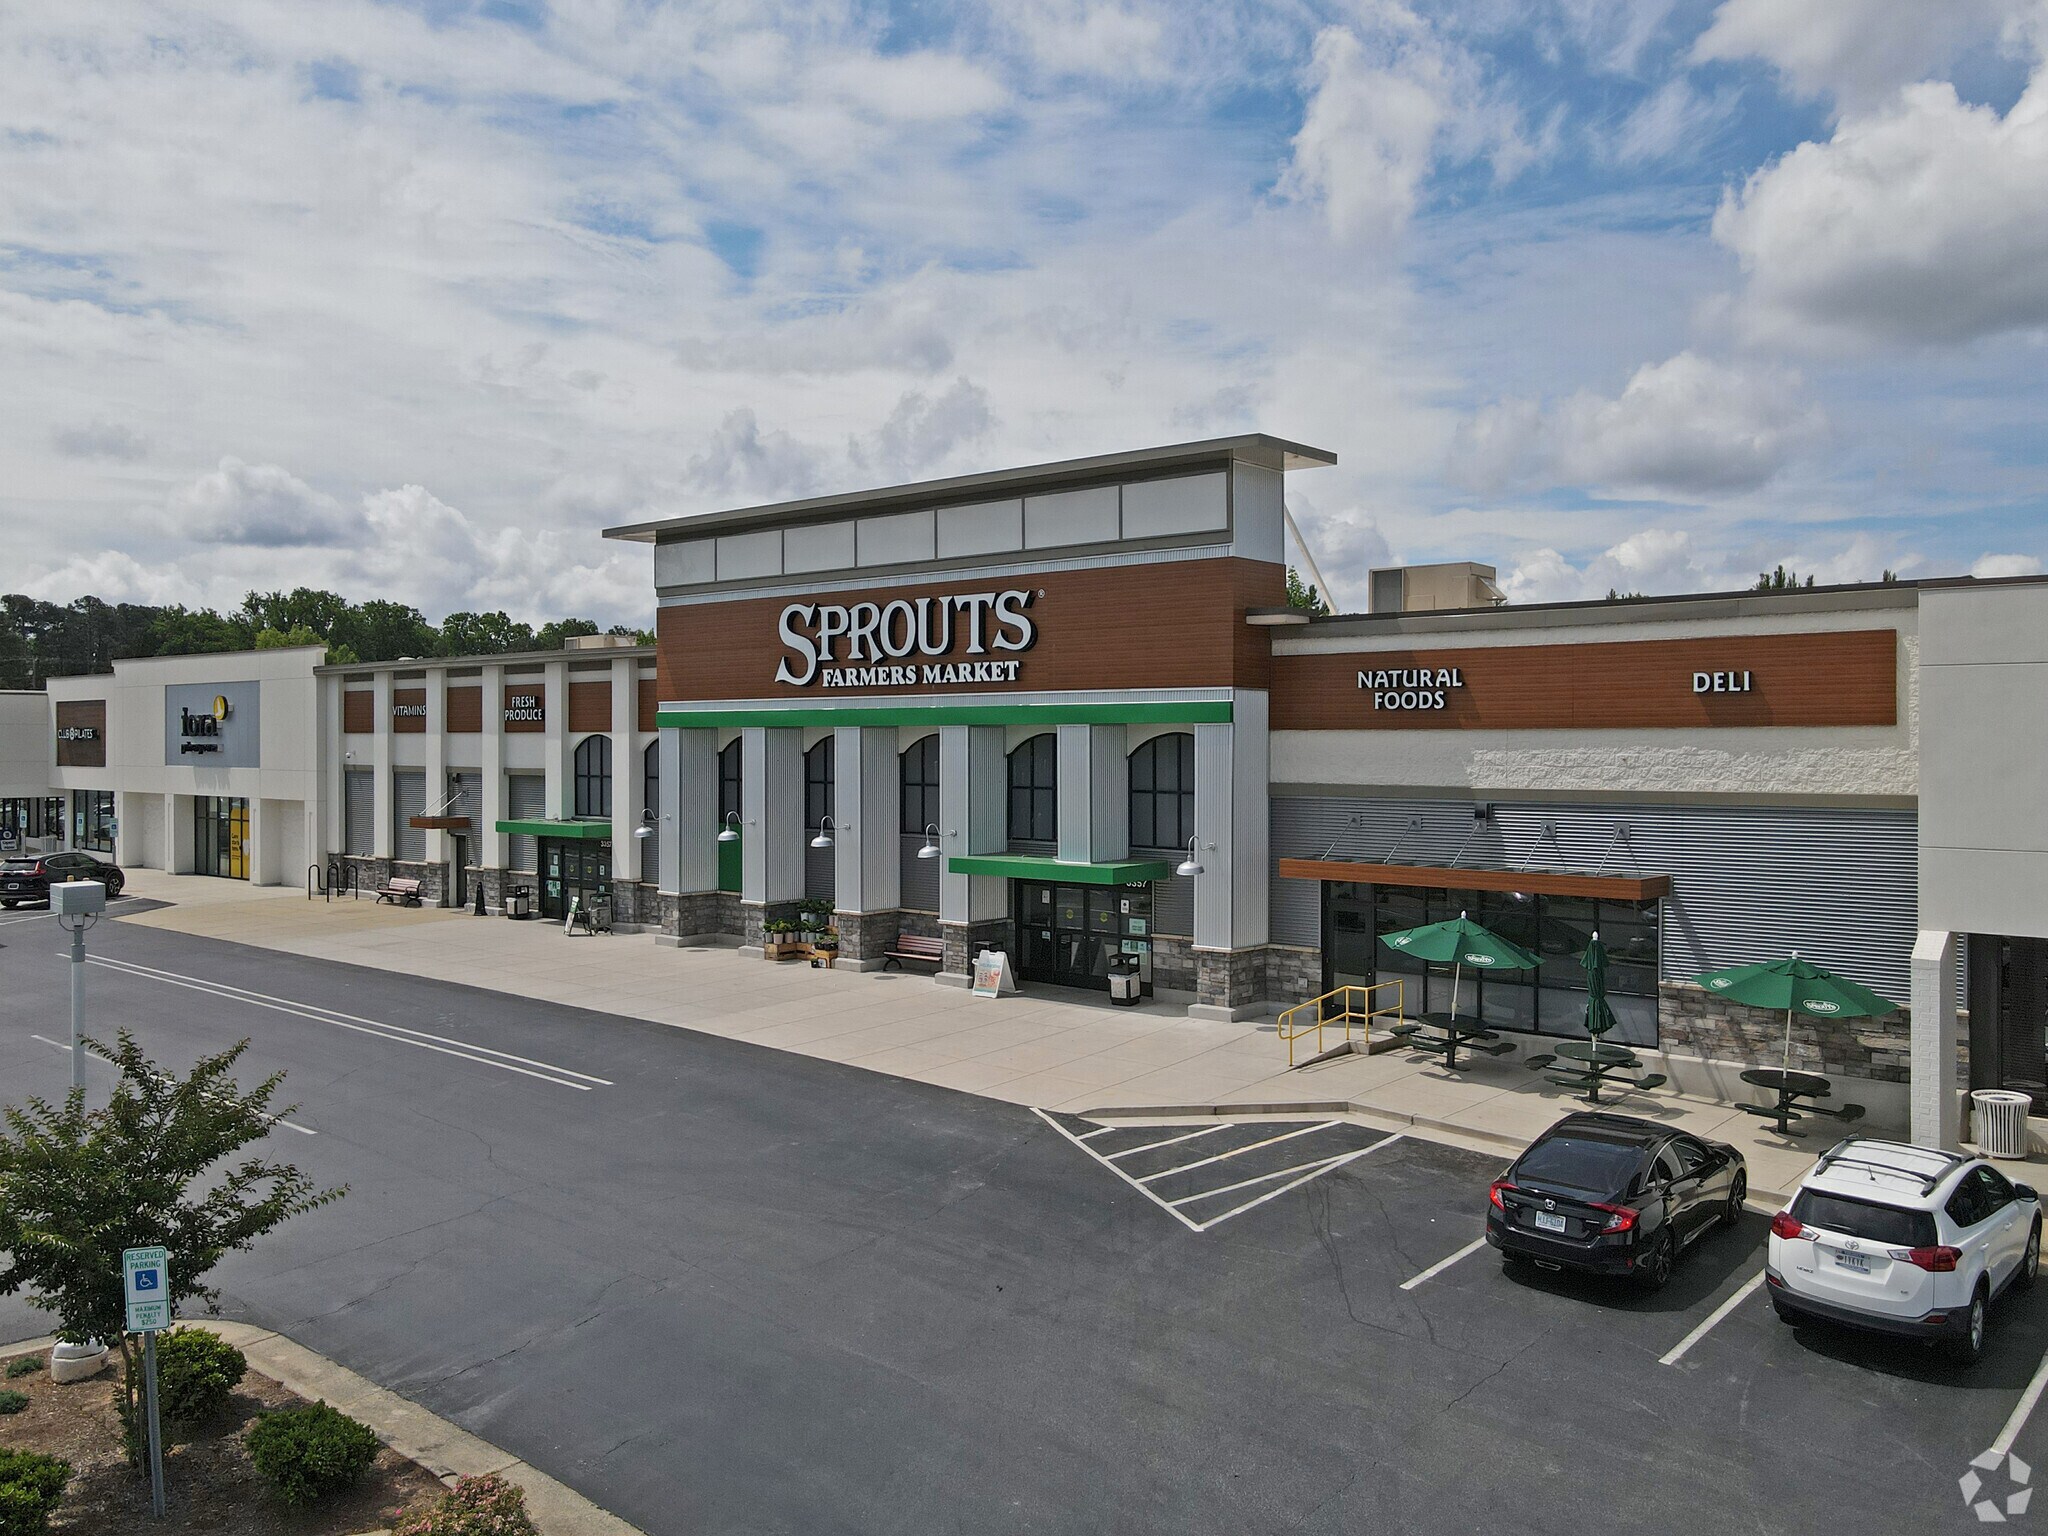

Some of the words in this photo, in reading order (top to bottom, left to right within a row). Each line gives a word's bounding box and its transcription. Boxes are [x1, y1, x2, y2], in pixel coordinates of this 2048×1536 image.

[775, 590, 1033, 686] SPROUTS
[822, 665, 917, 688] FARMERS
[922, 660, 1019, 684] MARKET
[1357, 668, 1463, 689] NATURAL
[1693, 670, 1751, 693] DELI
[511, 696, 535, 708] FRESH
[1374, 691, 1445, 711] FOODS
[392, 705, 426, 717] VITAMINS
[505, 709, 542, 722] PRODUCE
[126, 1251, 164, 1261] RESERVED
[130, 1260, 161, 1270] PARKING
